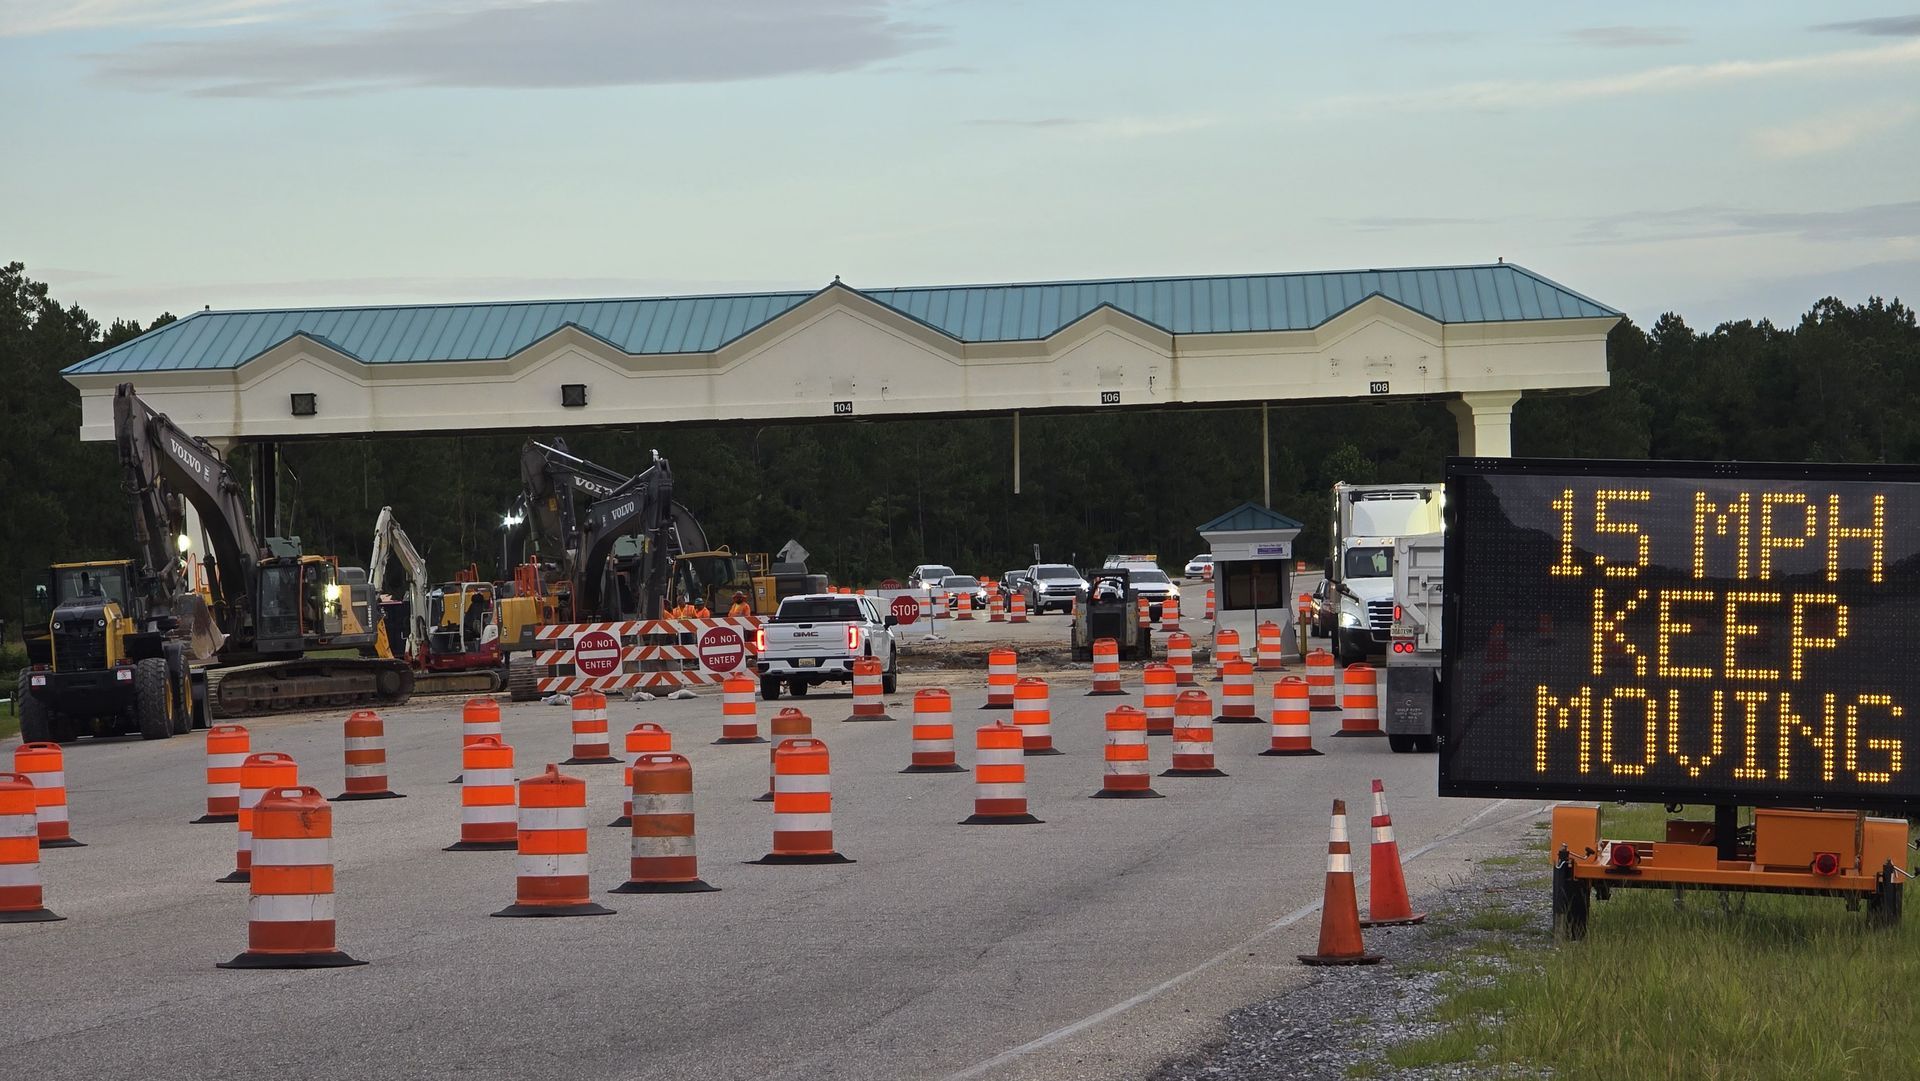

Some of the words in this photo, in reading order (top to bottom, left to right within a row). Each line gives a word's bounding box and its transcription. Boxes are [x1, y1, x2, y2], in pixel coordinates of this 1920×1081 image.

[1371, 382, 1388, 392] 108
[1102, 392, 1119, 402] 106
[834, 402, 852, 412] 104
[170, 438, 201, 473] VOLVO
[611, 502, 634, 520] VOLVO
[1550, 489, 1651, 577] 15
[1693, 491, 1886, 583] MPH
[892, 604, 918, 616] STOP
[704, 636, 716, 644] DO
[720, 634, 736, 644] NOT
[1592, 588, 1849, 680] KEEP
[581, 640, 592, 648] DO
[596, 639, 614, 648] NOT
[585, 660, 612, 669] ENTER
[709, 656, 736, 664] ENTER
[1536, 684, 1903, 783] MOVING
